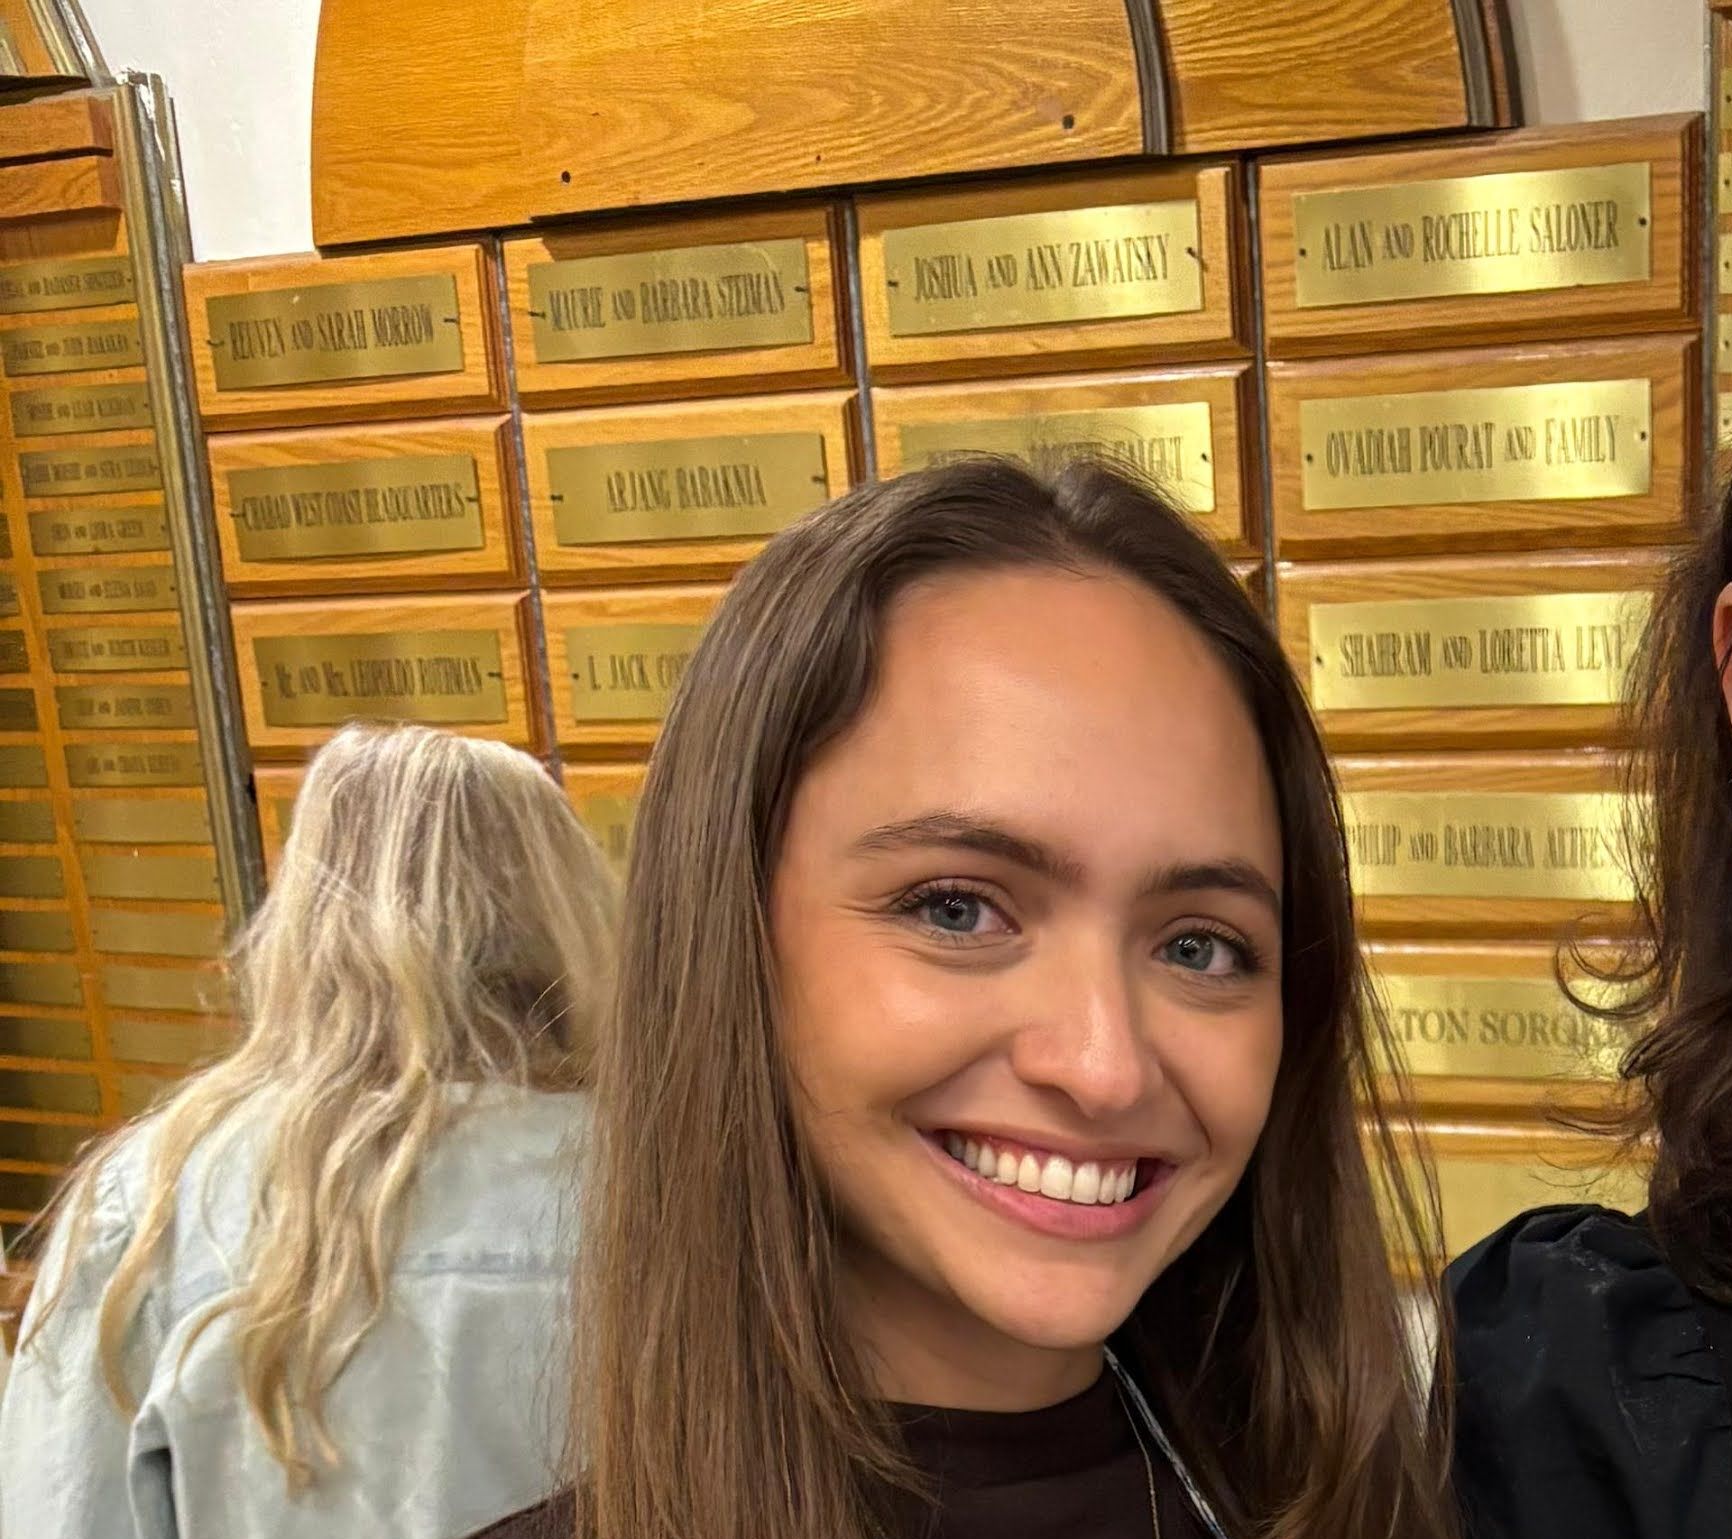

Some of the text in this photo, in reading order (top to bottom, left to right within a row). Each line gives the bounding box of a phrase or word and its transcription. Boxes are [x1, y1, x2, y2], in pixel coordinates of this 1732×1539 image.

[1323, 200, 1619, 271] ALAN AND ROCHELLE SALONER
[914, 254, 977, 302] JOSHUA
[986, 254, 1018, 289] AND
[1026, 243, 1064, 291] ANN
[229, 303, 435, 362] REUVEN AND SARAH MORROW
[612, 289, 637, 321] AND
[1419, 421, 1496, 473] POURAT
[1504, 426, 1536, 462] AND
[1544, 415, 1621, 465] FAMILY
[1441, 635, 1473, 671] AND
[1478, 627, 1566, 675] LORETTA
[1408, 831, 1439, 863] AND
[1443, 823, 1535, 870] BARBARA
